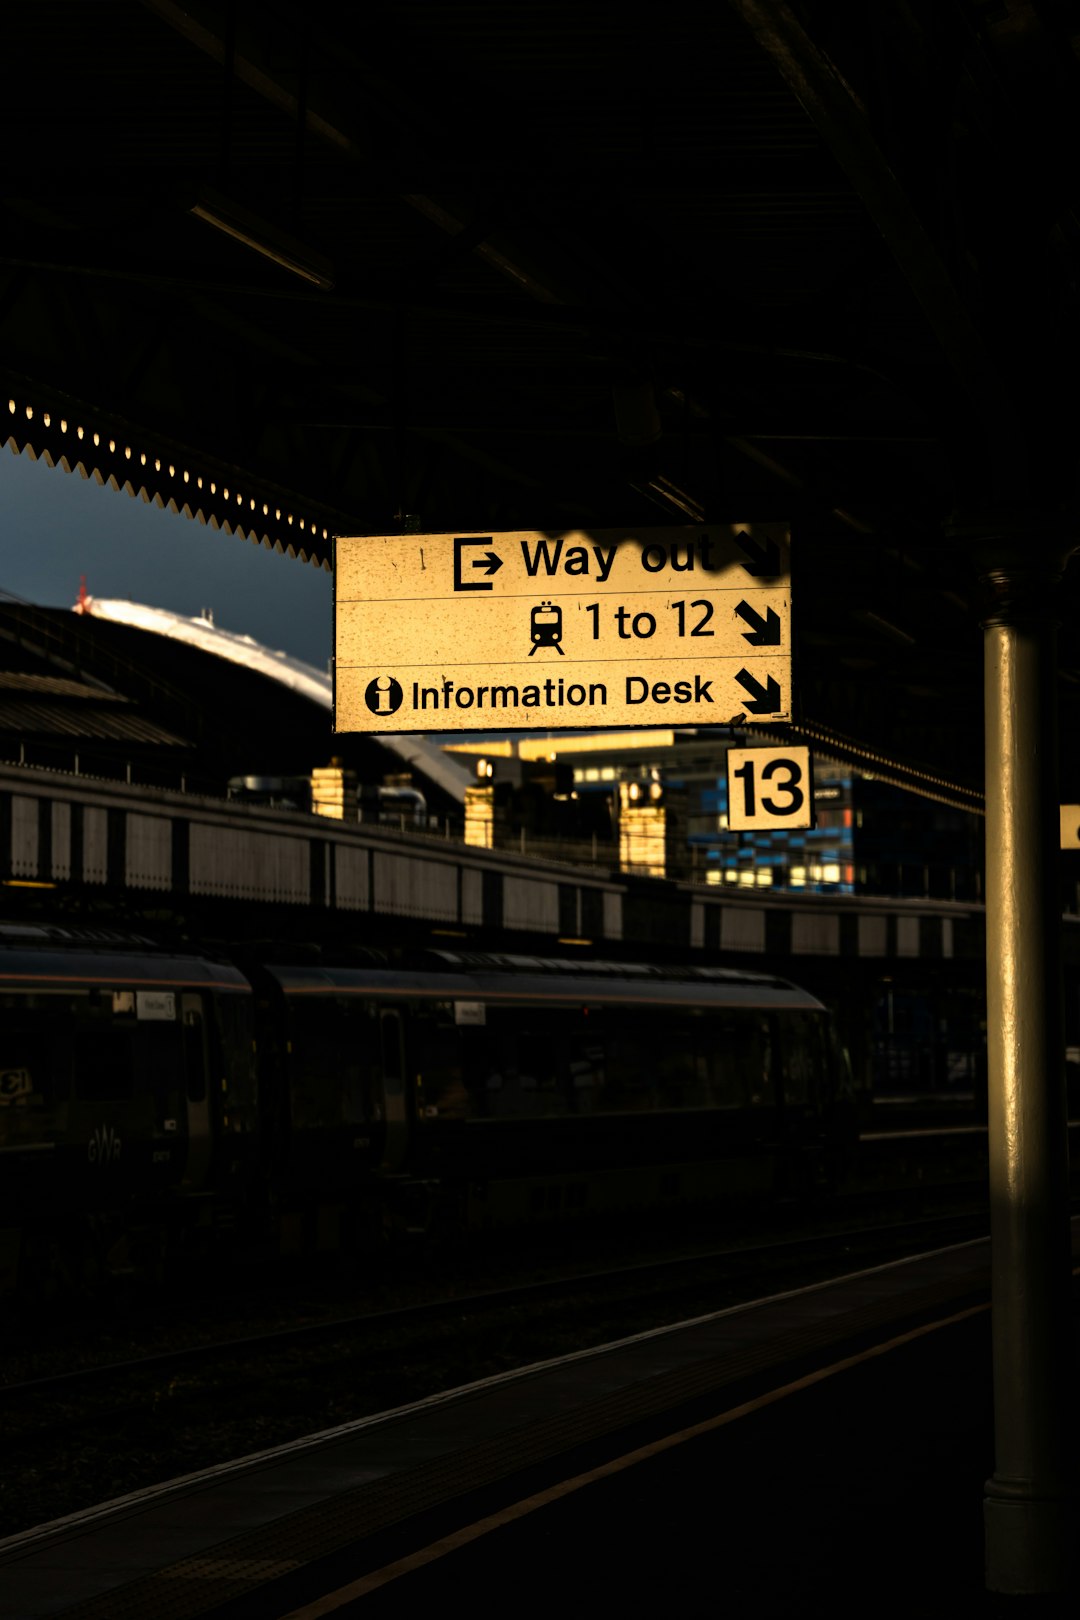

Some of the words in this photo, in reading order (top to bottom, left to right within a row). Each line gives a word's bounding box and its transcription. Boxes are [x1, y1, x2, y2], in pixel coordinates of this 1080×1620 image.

[521, 539, 616, 582] Way
[641, 534, 715, 573] out
[585, 603, 600, 640] 1
[614, 606, 657, 639] to
[671, 600, 715, 638] 12
[412, 678, 607, 710] Information
[625, 675, 714, 704] Desk
[734, 759, 803, 817] 13
[87, 1122, 122, 1167] GWR
